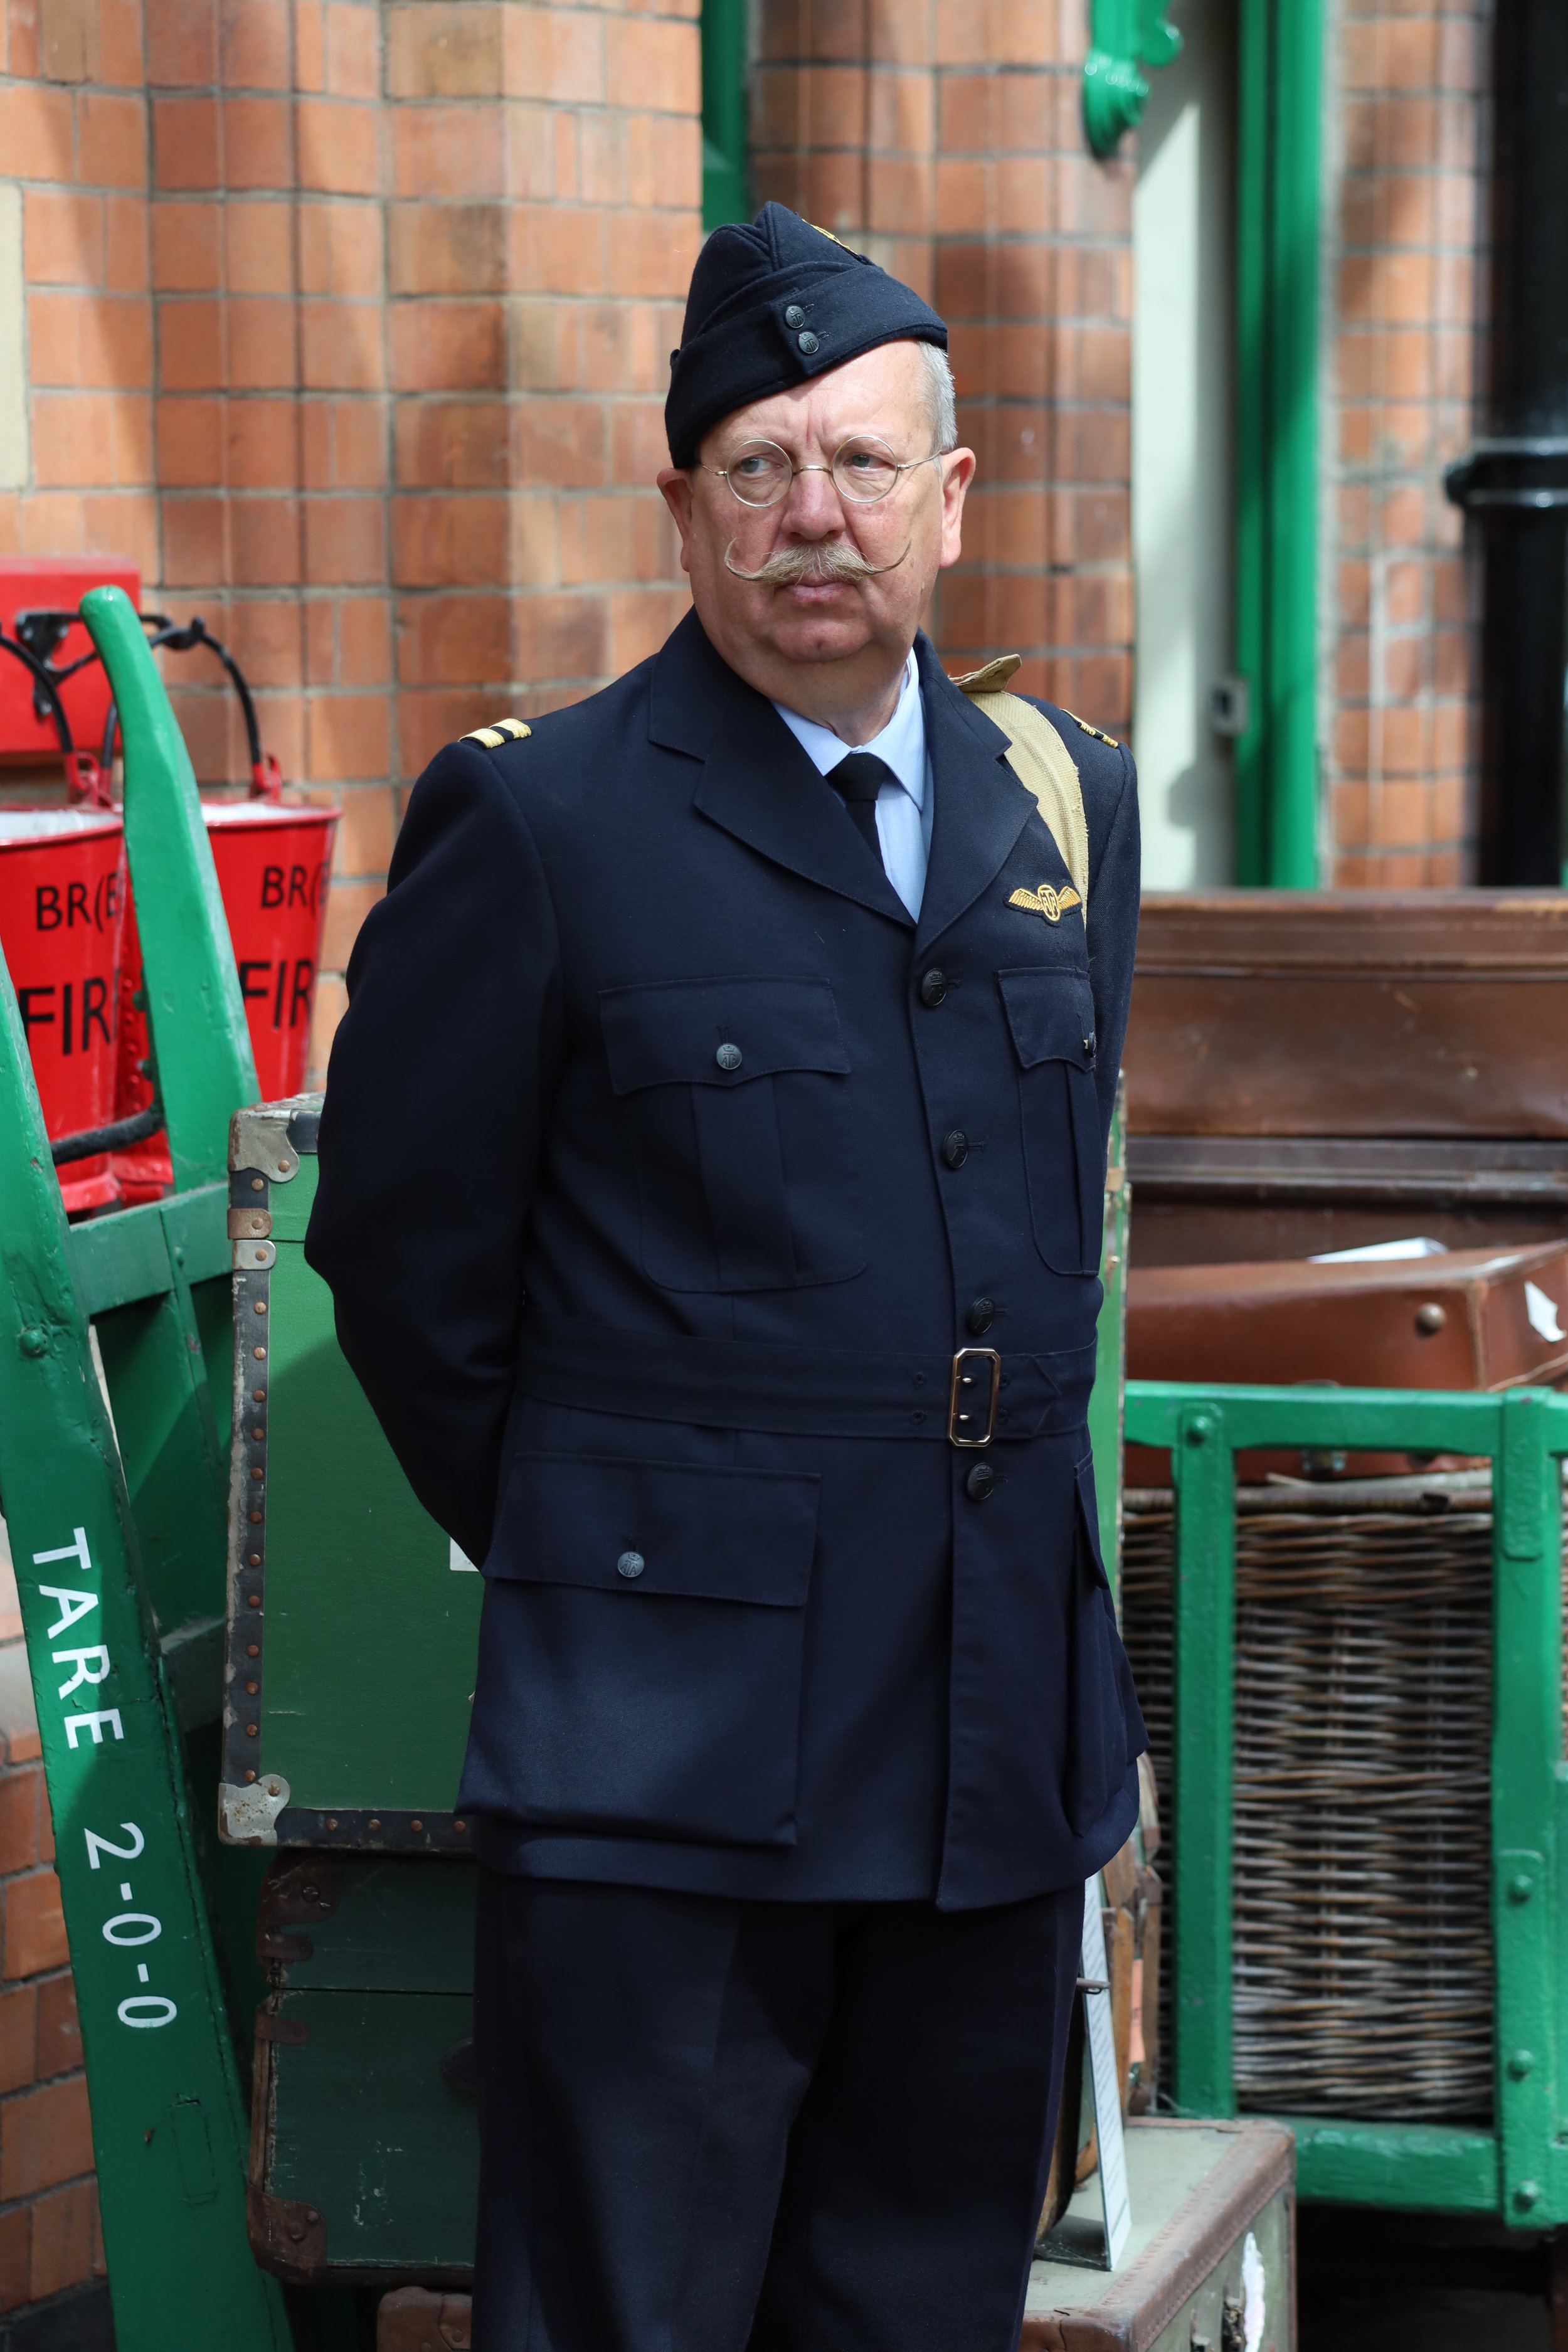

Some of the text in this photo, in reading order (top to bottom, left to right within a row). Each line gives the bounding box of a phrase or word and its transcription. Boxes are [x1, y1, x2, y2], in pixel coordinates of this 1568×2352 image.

[18, 968, 120, 1056] FIR
[33, 1527, 177, 2028] TARE 2-0-0
